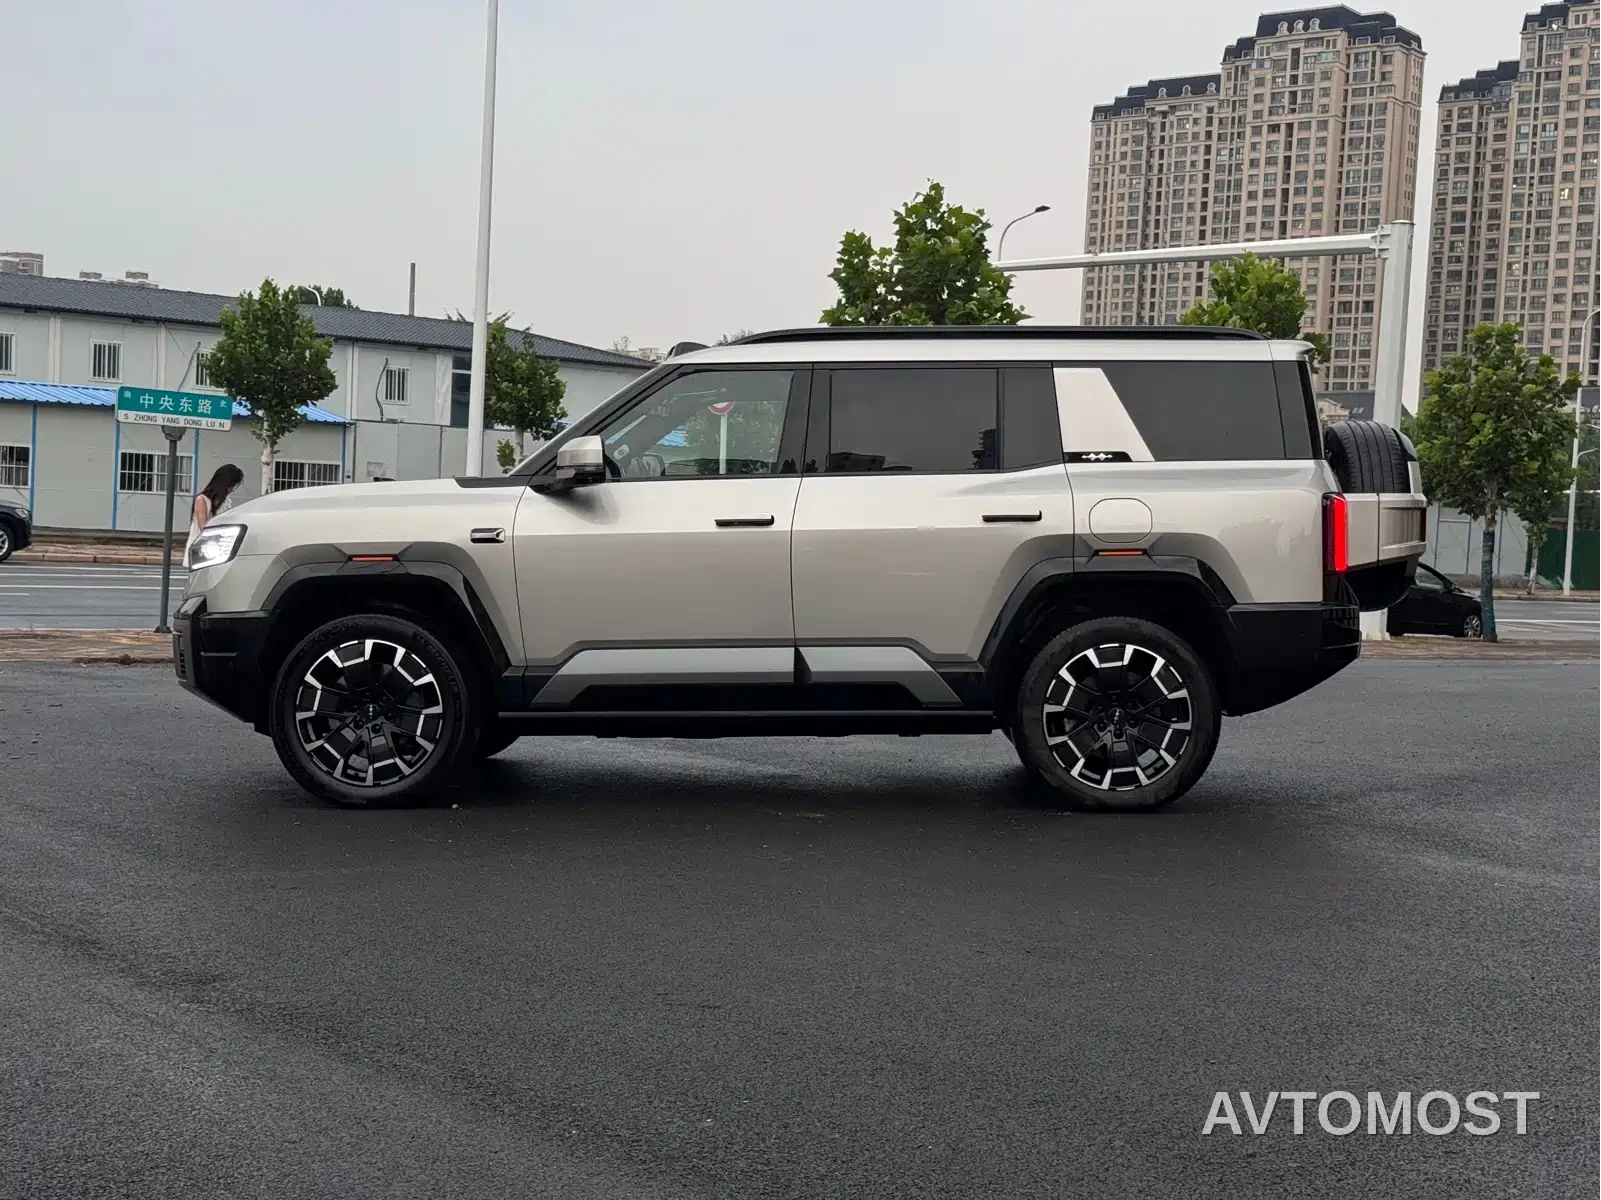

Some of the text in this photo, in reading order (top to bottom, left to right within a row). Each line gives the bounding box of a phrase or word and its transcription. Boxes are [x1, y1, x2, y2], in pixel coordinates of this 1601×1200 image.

[139, 392, 213, 415] 中央东路
[133, 413, 158, 423] ZHONG
[161, 416, 180, 425] YANG
[183, 418, 202, 427] DONG
[205, 420, 216, 428] LU
